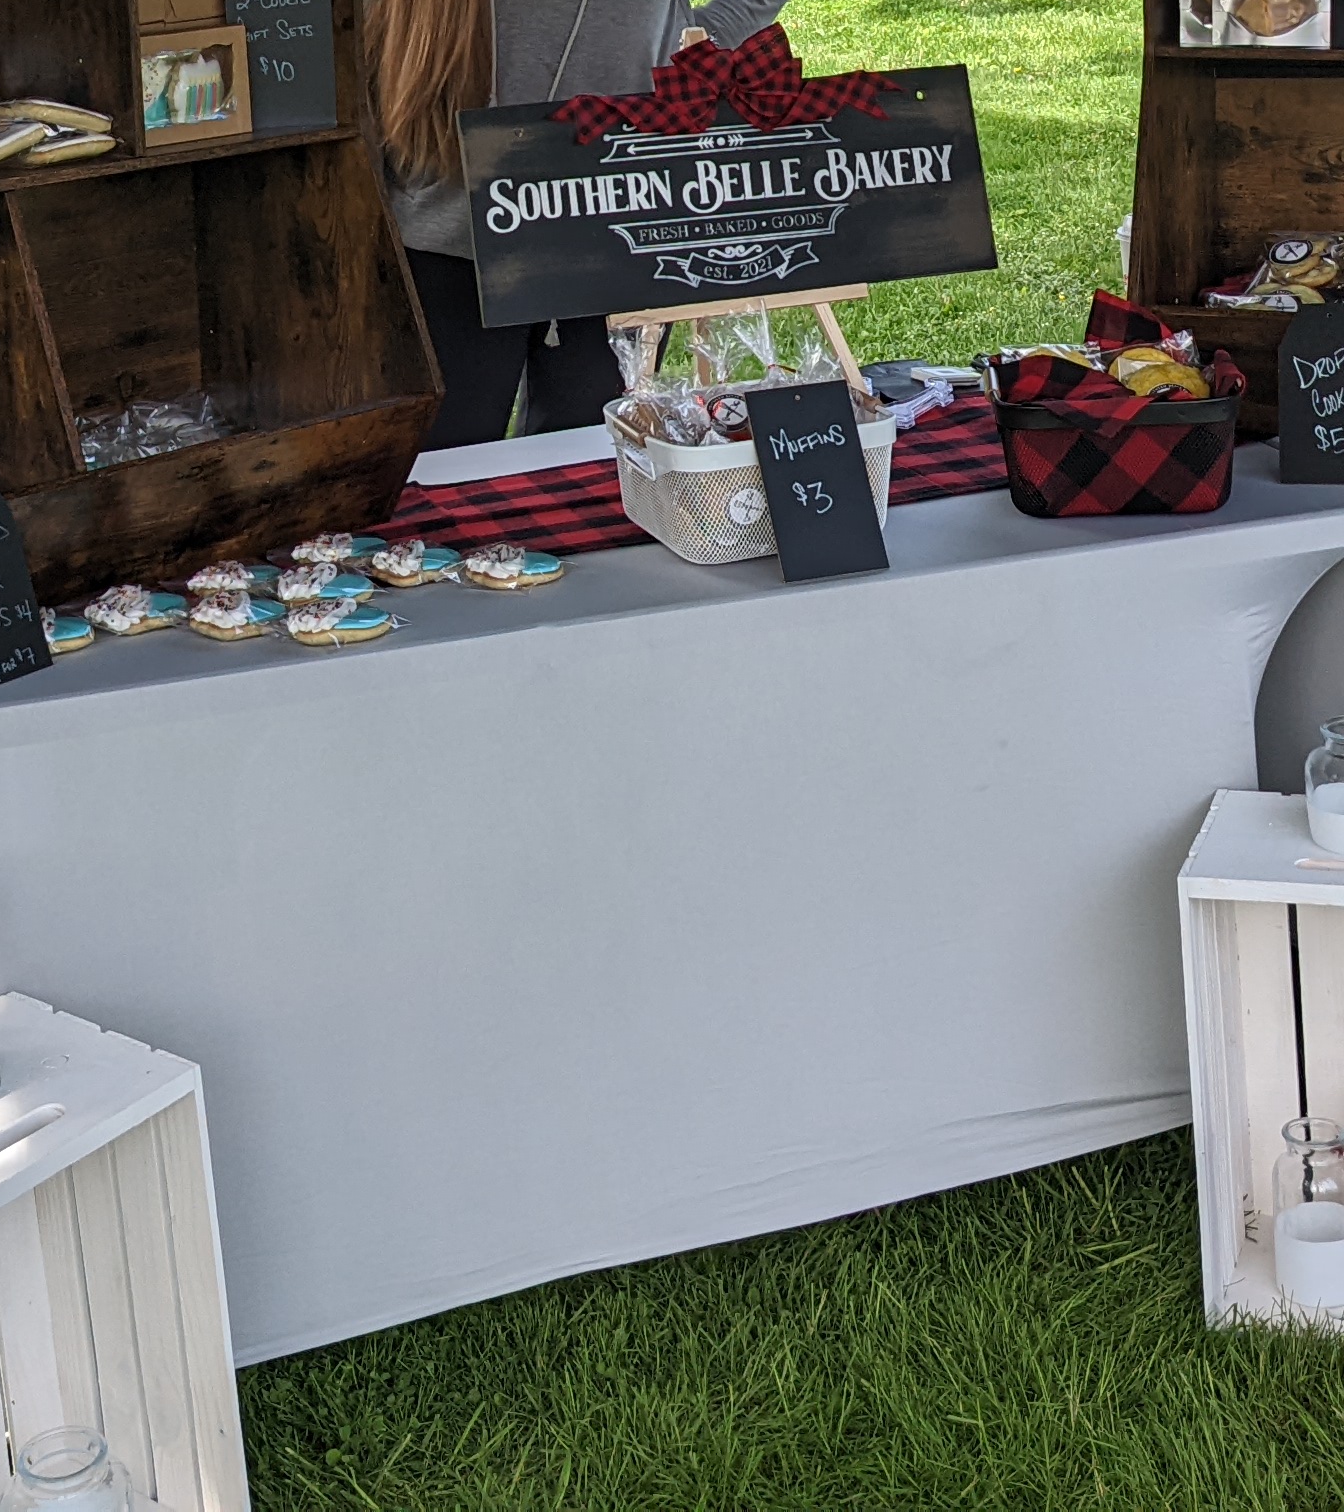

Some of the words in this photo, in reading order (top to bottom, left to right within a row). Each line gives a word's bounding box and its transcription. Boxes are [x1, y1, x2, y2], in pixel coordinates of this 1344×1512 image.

[276, 19, 313, 41] SETS
[259, 56, 295, 82] $10
[485, 169, 674, 234] SOUTHERN
[682, 158, 806, 215] BELLE
[813, 144, 954, 202] BAKERY
[638, 224, 690, 244] FRESH
[704, 218, 757, 236] BAKED
[770, 212, 825, 230] GOODS
[703, 265, 734, 280] est.
[739, 255, 774, 279] 2021
[769, 424, 846, 461] MUFFINS
[792, 481, 834, 514] $3
[15, 599, 32, 622] $4
